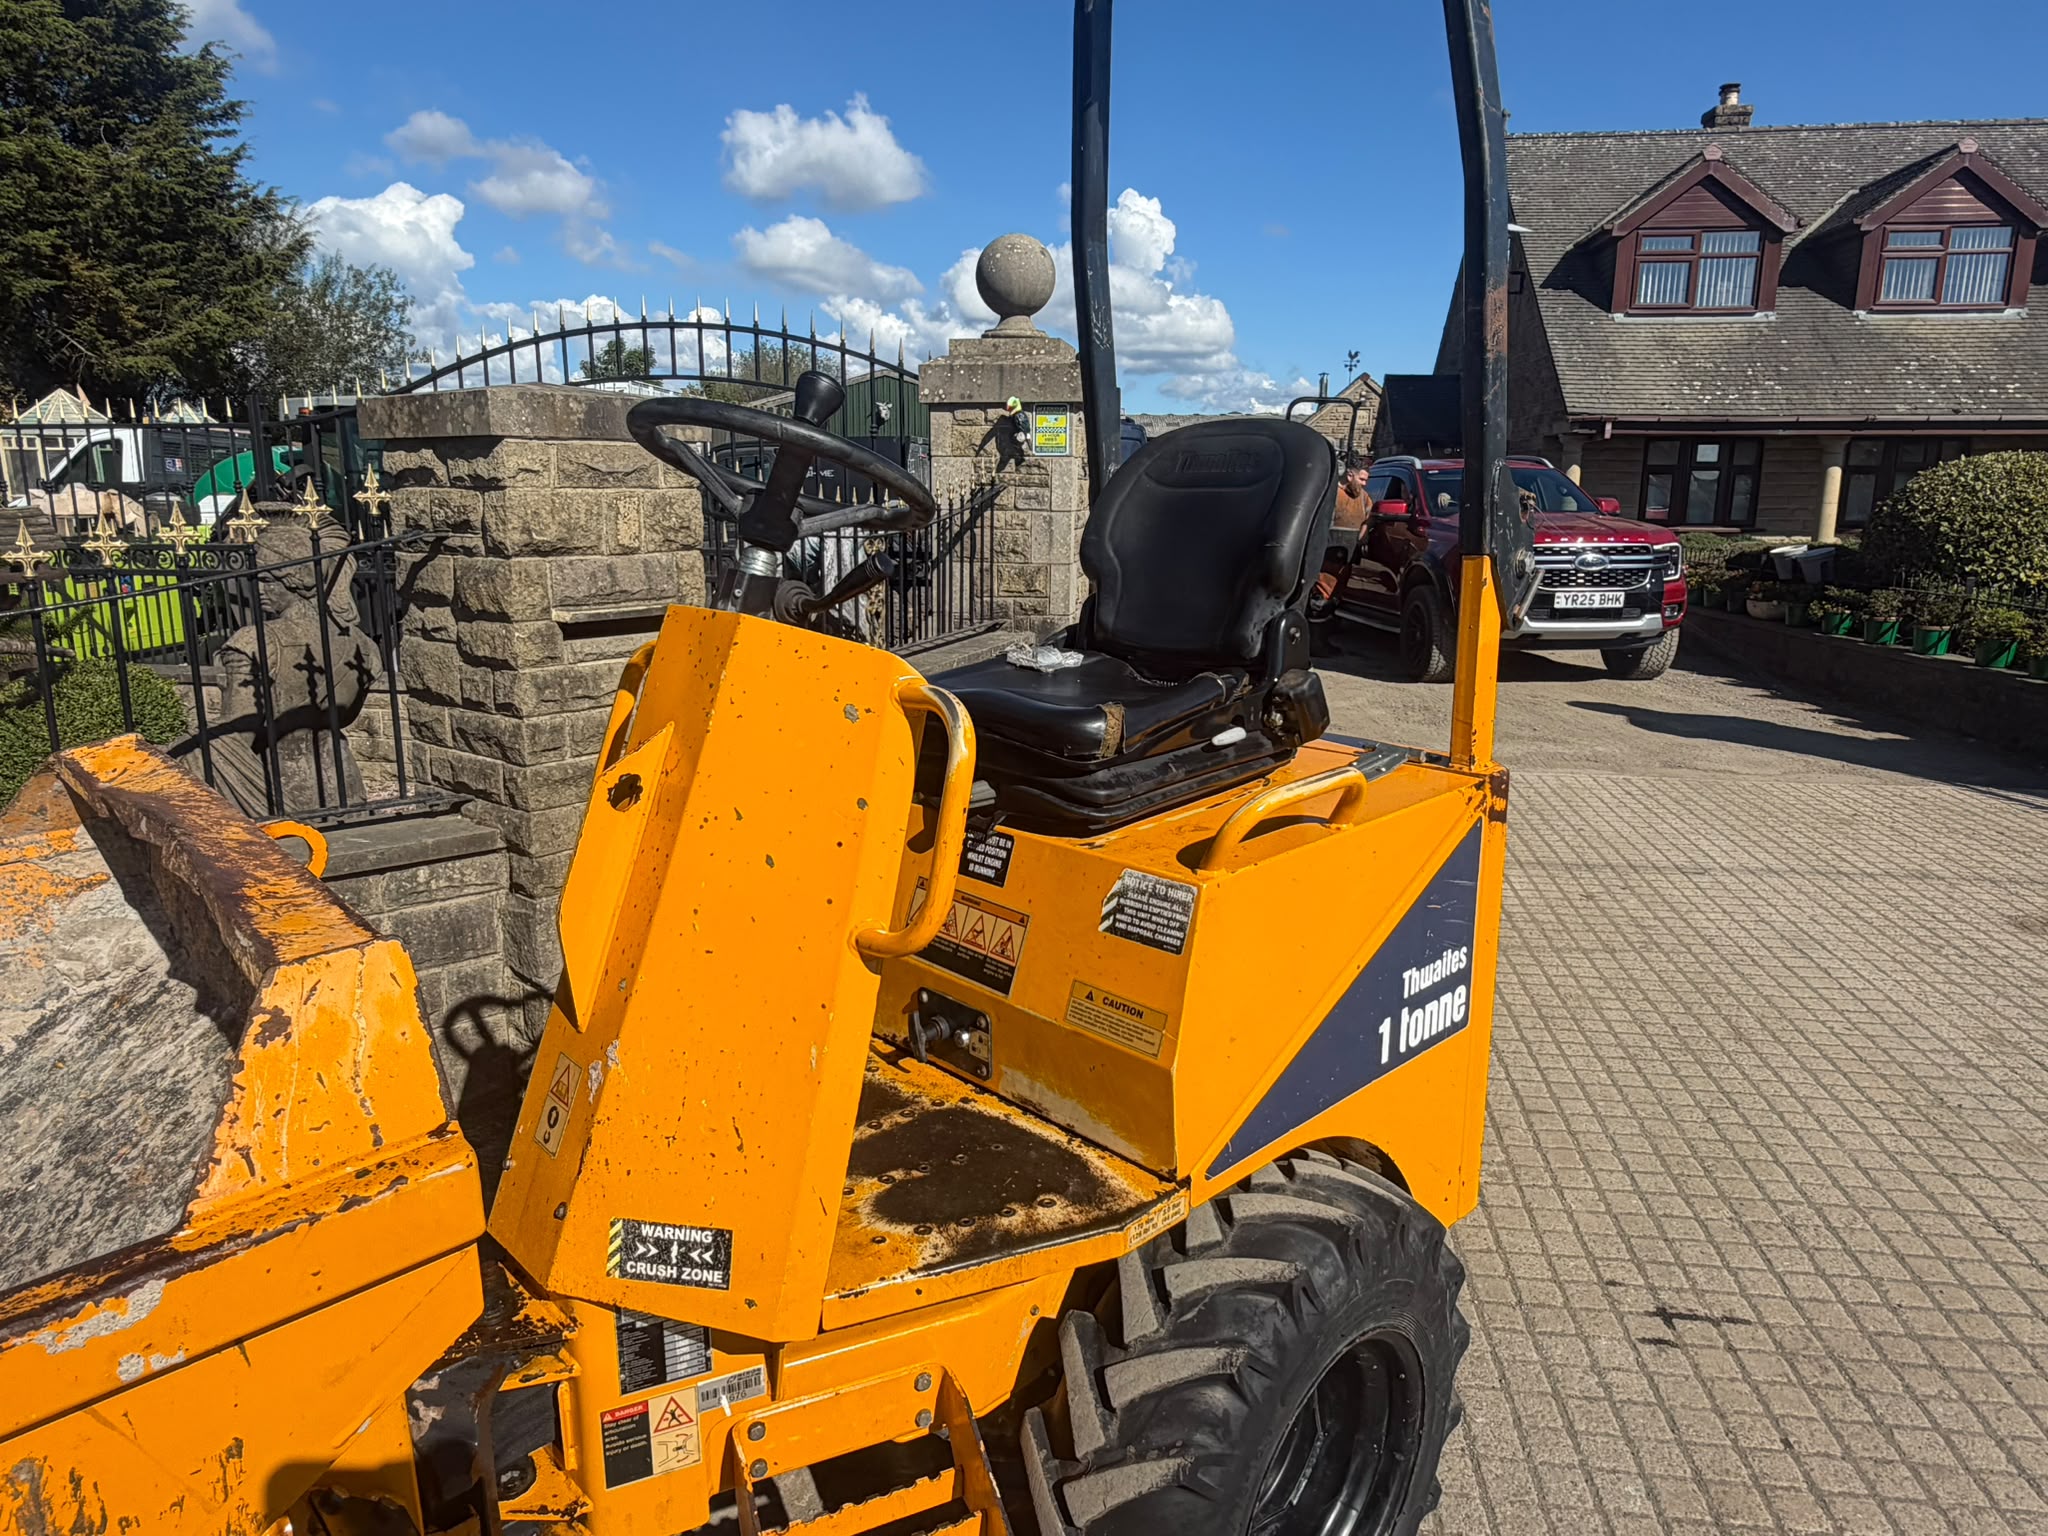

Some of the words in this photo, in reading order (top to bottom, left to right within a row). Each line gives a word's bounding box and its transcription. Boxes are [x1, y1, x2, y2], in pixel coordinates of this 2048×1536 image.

[1564, 594, 1596, 606] YR25
[1599, 594, 1622, 605] BHK
[985, 845, 1007, 858] POSITION
[974, 864, 995, 878] RUNNING
[984, 856, 1002, 869] ENGINE
[1125, 876, 1154, 892] NOTICE
[1156, 885, 1166, 895] TO
[1168, 888, 1193, 902] HIRER
[1120, 897, 1142, 909] RUBBISH
[1149, 906, 1172, 918] EMPTIED
[1172, 912, 1188, 922] FROM
[1149, 898, 1171, 909] ENSURE
[1172, 904, 1182, 912] ALL
[1116, 913, 1131, 922] HIRED
[1140, 920, 1156, 930] AVOID
[1157, 925, 1184, 938] CLEANING
[1124, 907, 1136, 915] THIS
[1138, 911, 1150, 920] UNIT
[1152, 914, 1168, 925] WHEN
[1169, 919, 1180, 928] OFF
[1115, 922, 1126, 930] AND
[1128, 925, 1153, 938] DISPOSAL
[1155, 933, 1180, 946] CHARGES
[1403, 946, 1467, 999] Thwaites
[1102, 996, 1144, 1019] CAUTION
[1379, 1016, 1391, 1064] 1
[1399, 984, 1466, 1053] tonne
[641, 1224, 712, 1243] WARNING
[626, 1261, 677, 1278] CRUSH
[681, 1267, 723, 1283] ZONE
[614, 1405, 643, 1417] DANGER
